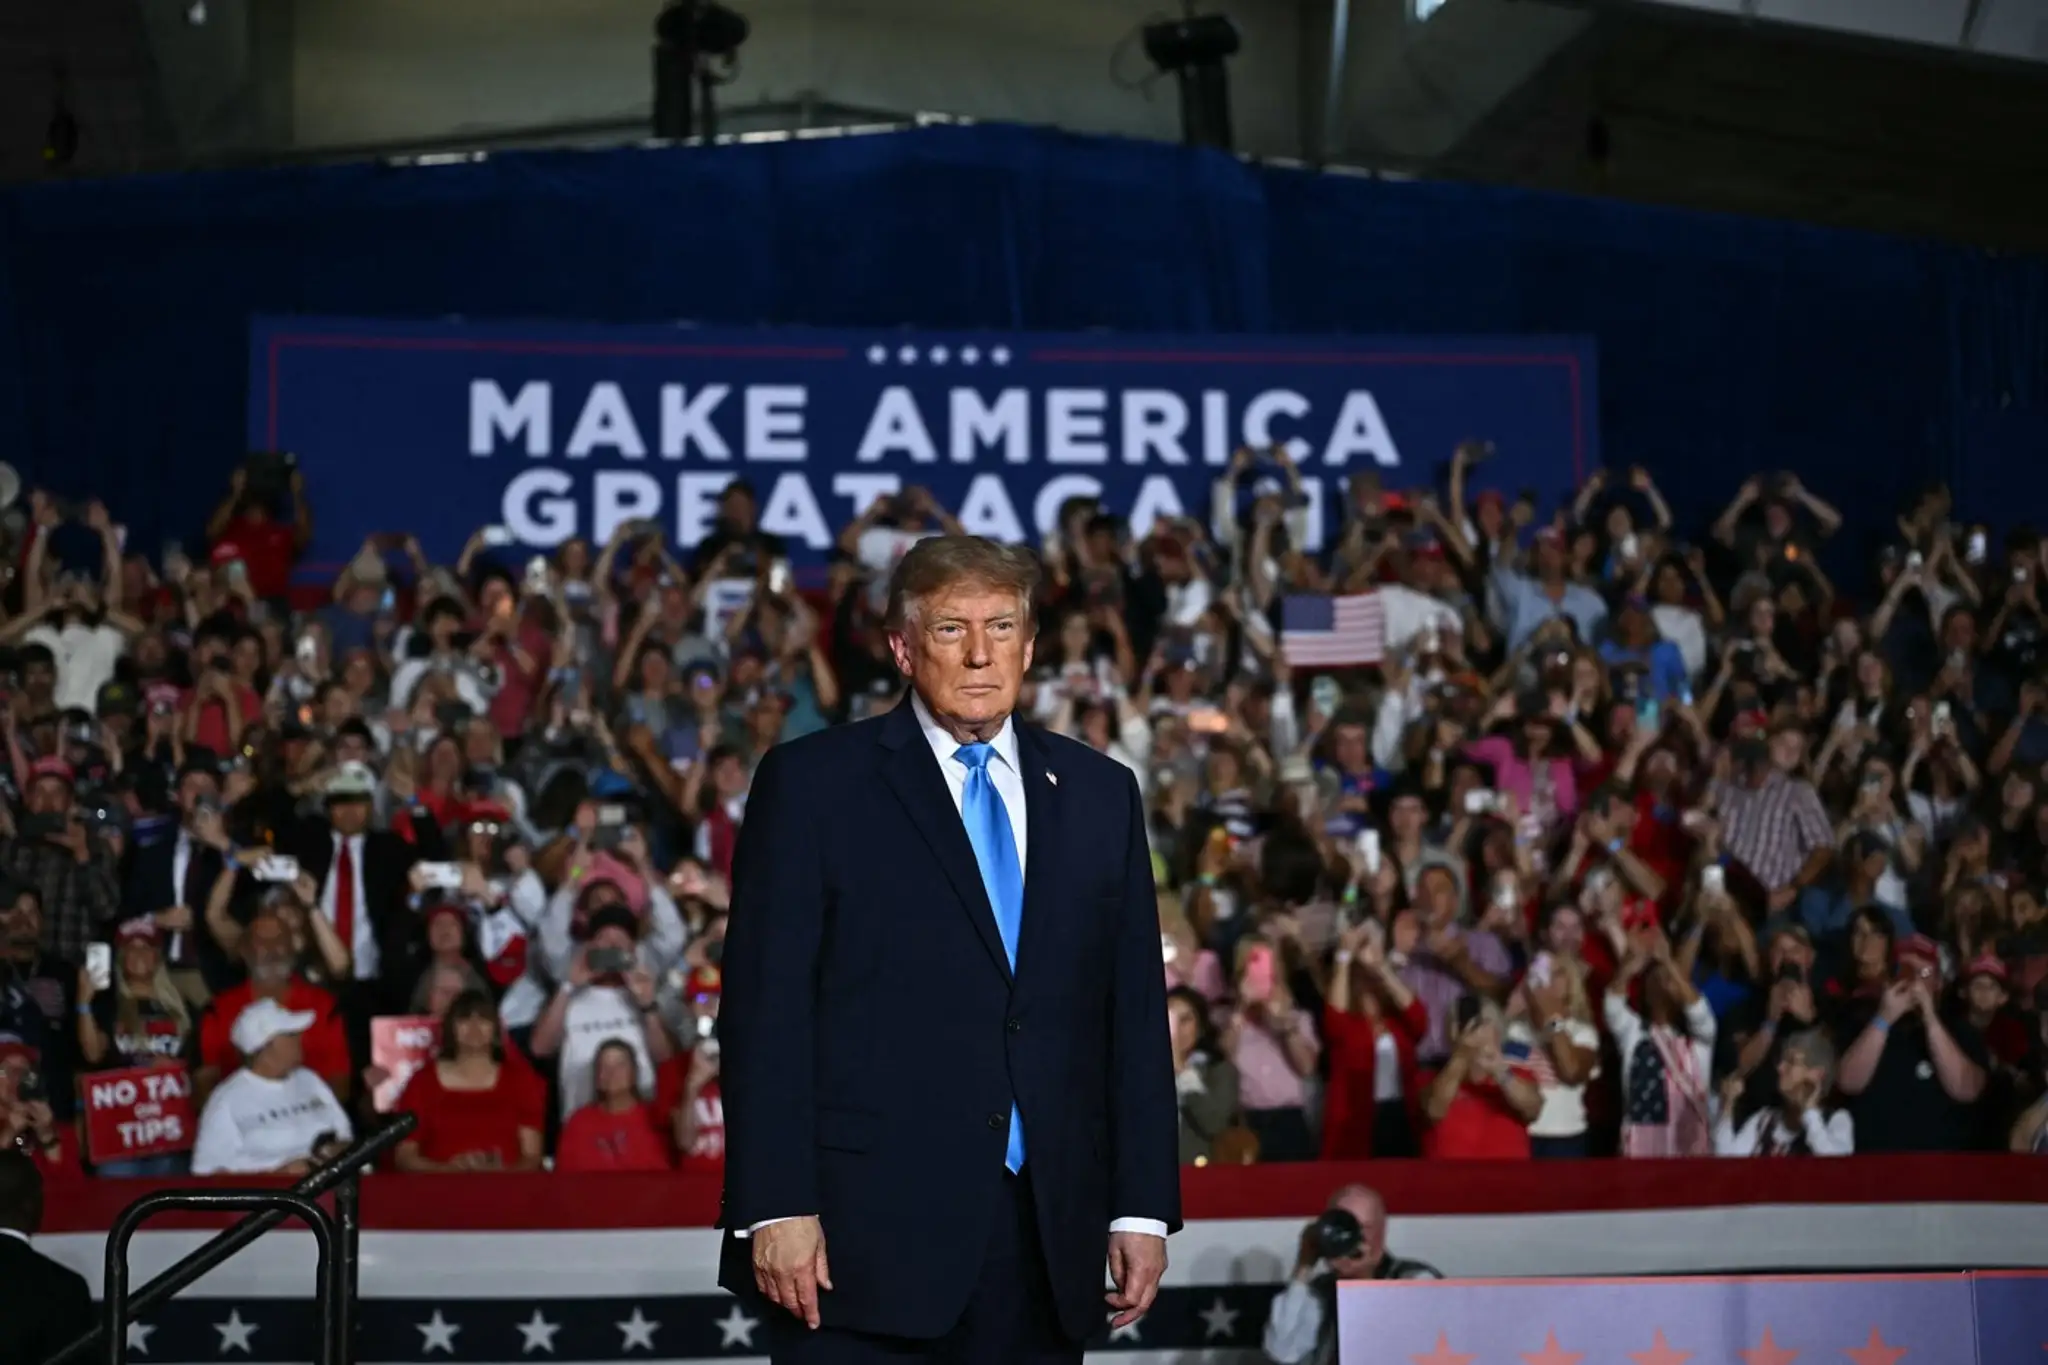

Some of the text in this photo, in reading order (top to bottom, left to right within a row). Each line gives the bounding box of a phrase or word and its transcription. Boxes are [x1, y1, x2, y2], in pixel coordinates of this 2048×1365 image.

[468, 377, 1401, 467] MAKE AMERICA
[501, 467, 902, 550] GREAT
[395, 1026, 434, 1049] NO
[91, 1080, 137, 1109] NO
[117, 1115, 183, 1148] TIPS
